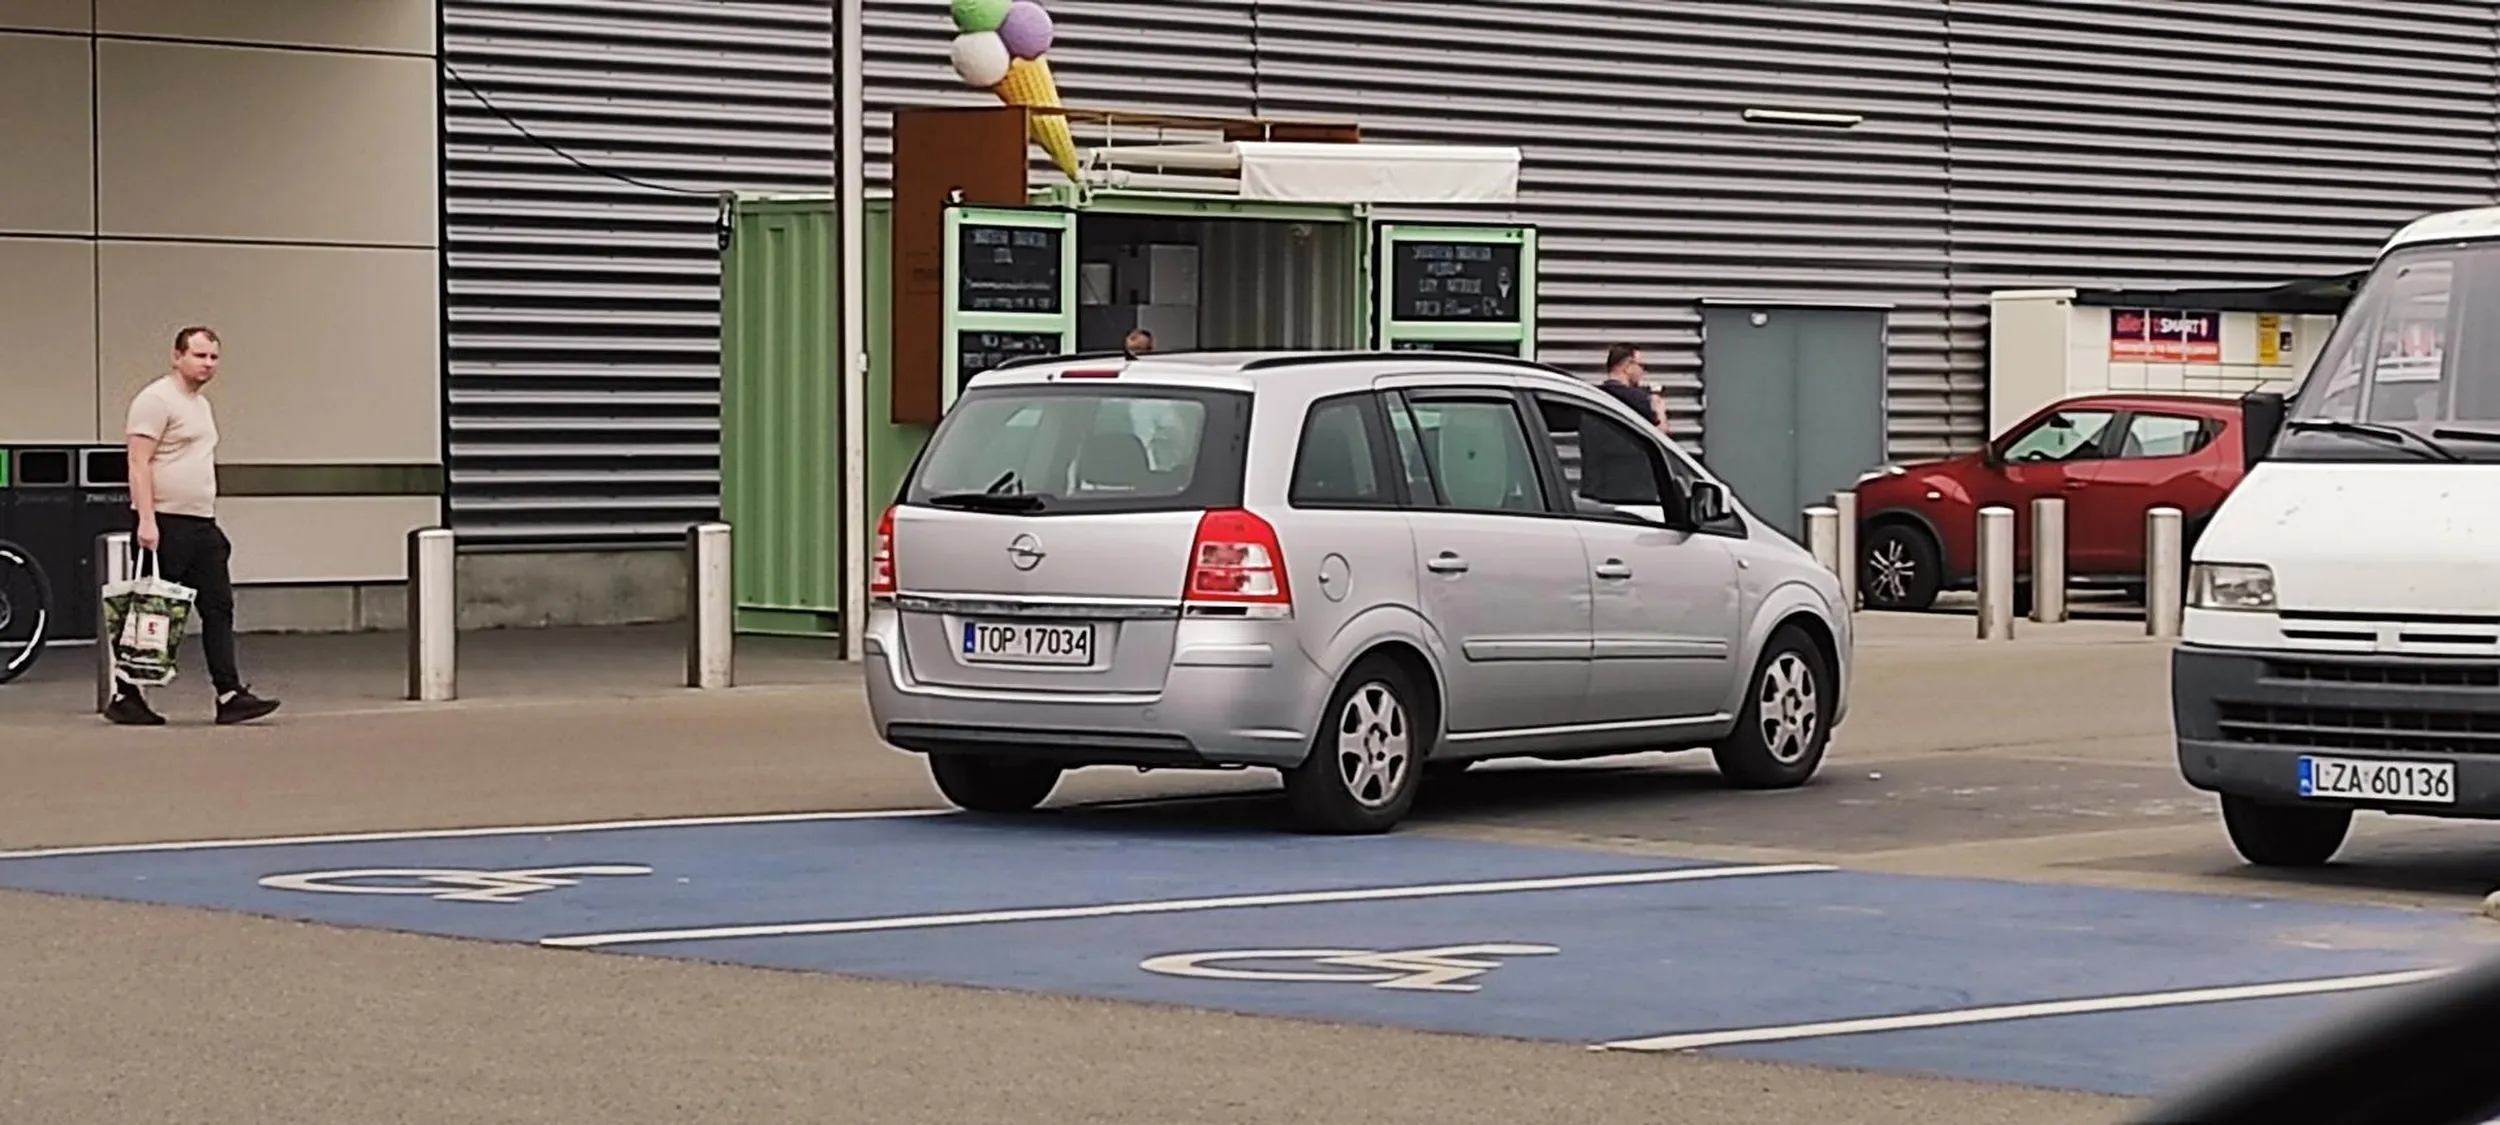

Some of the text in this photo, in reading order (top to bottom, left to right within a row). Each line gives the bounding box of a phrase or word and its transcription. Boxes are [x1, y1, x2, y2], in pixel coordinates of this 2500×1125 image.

[977, 625, 1087, 655] TOP 17034
[2315, 763, 2449, 797] LZA 60136
